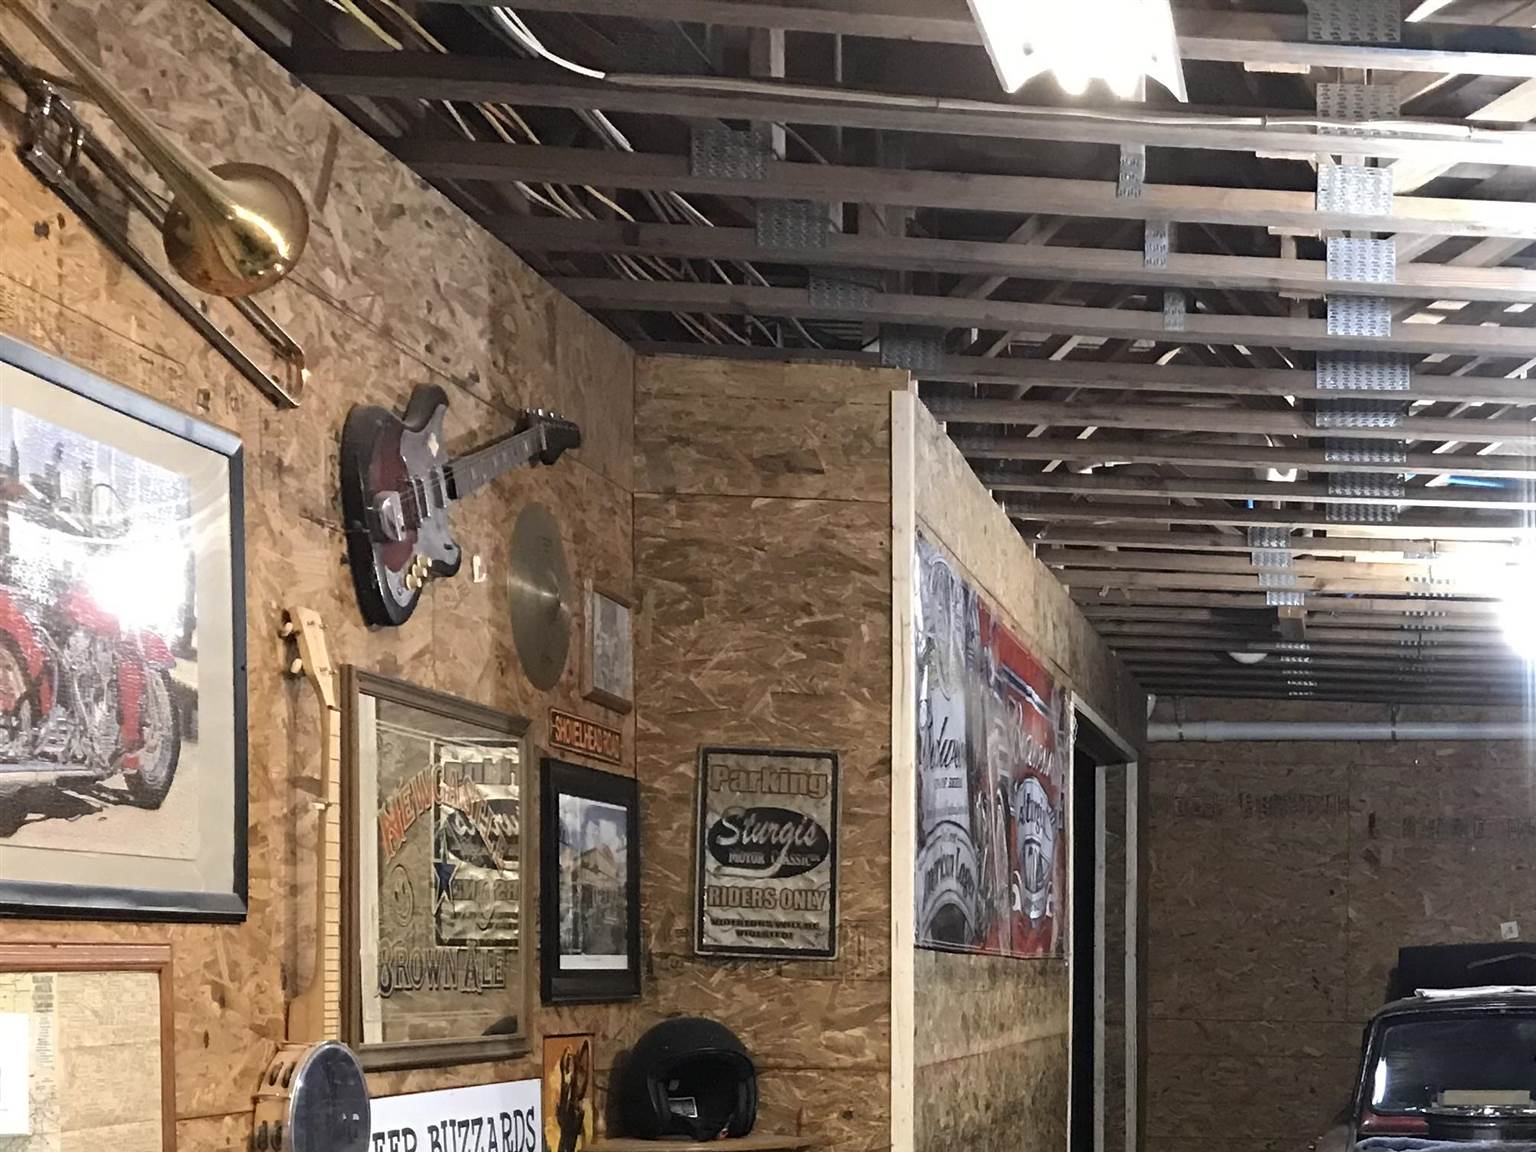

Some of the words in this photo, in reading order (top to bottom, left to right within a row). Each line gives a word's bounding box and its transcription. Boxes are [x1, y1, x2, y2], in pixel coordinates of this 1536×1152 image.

[710, 764, 829, 799] Parking
[715, 805, 818, 867] Sturgis
[728, 851, 766, 865] MOTOR
[707, 885, 777, 910] RIDERS
[779, 887, 828, 912] ONLY
[376, 941, 459, 998] BROWN
[460, 941, 507, 995] ALE
